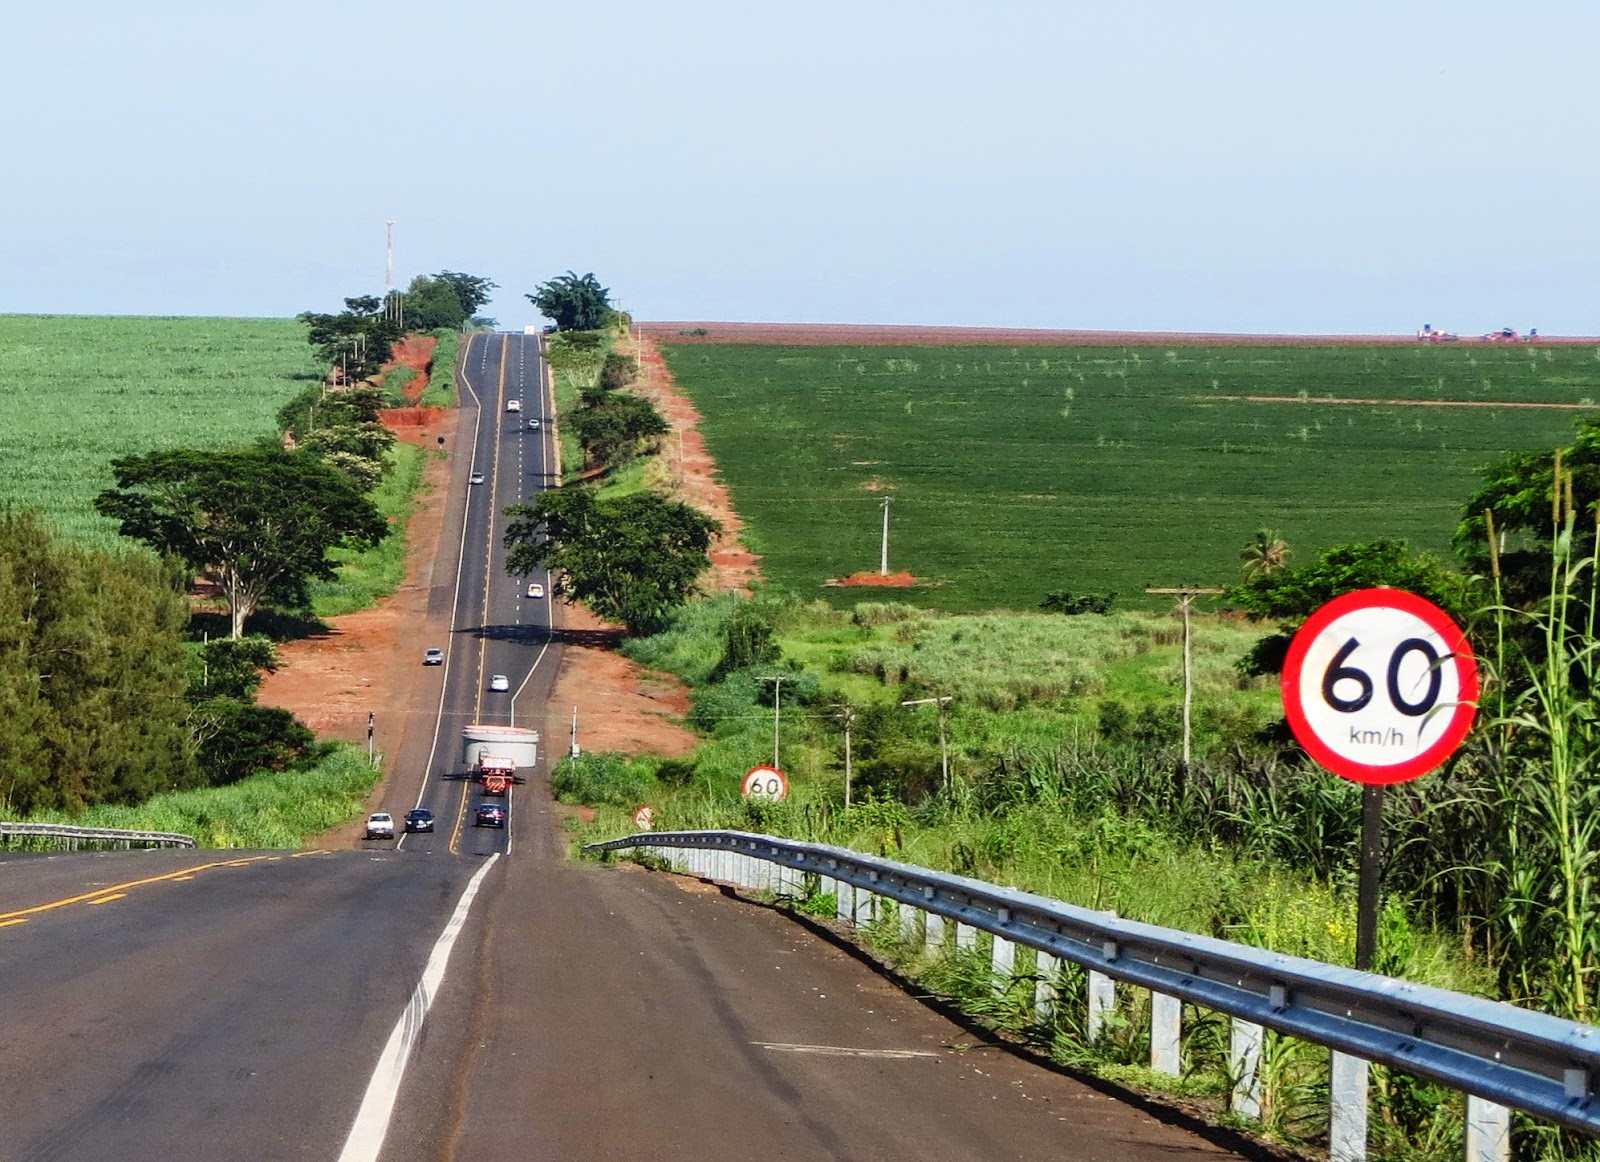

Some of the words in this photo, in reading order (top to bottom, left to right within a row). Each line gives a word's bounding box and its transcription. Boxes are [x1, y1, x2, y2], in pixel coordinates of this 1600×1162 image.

[1321, 636, 1442, 717] 60
[1349, 725, 1404, 747] km/h
[751, 777, 778, 795] 60
